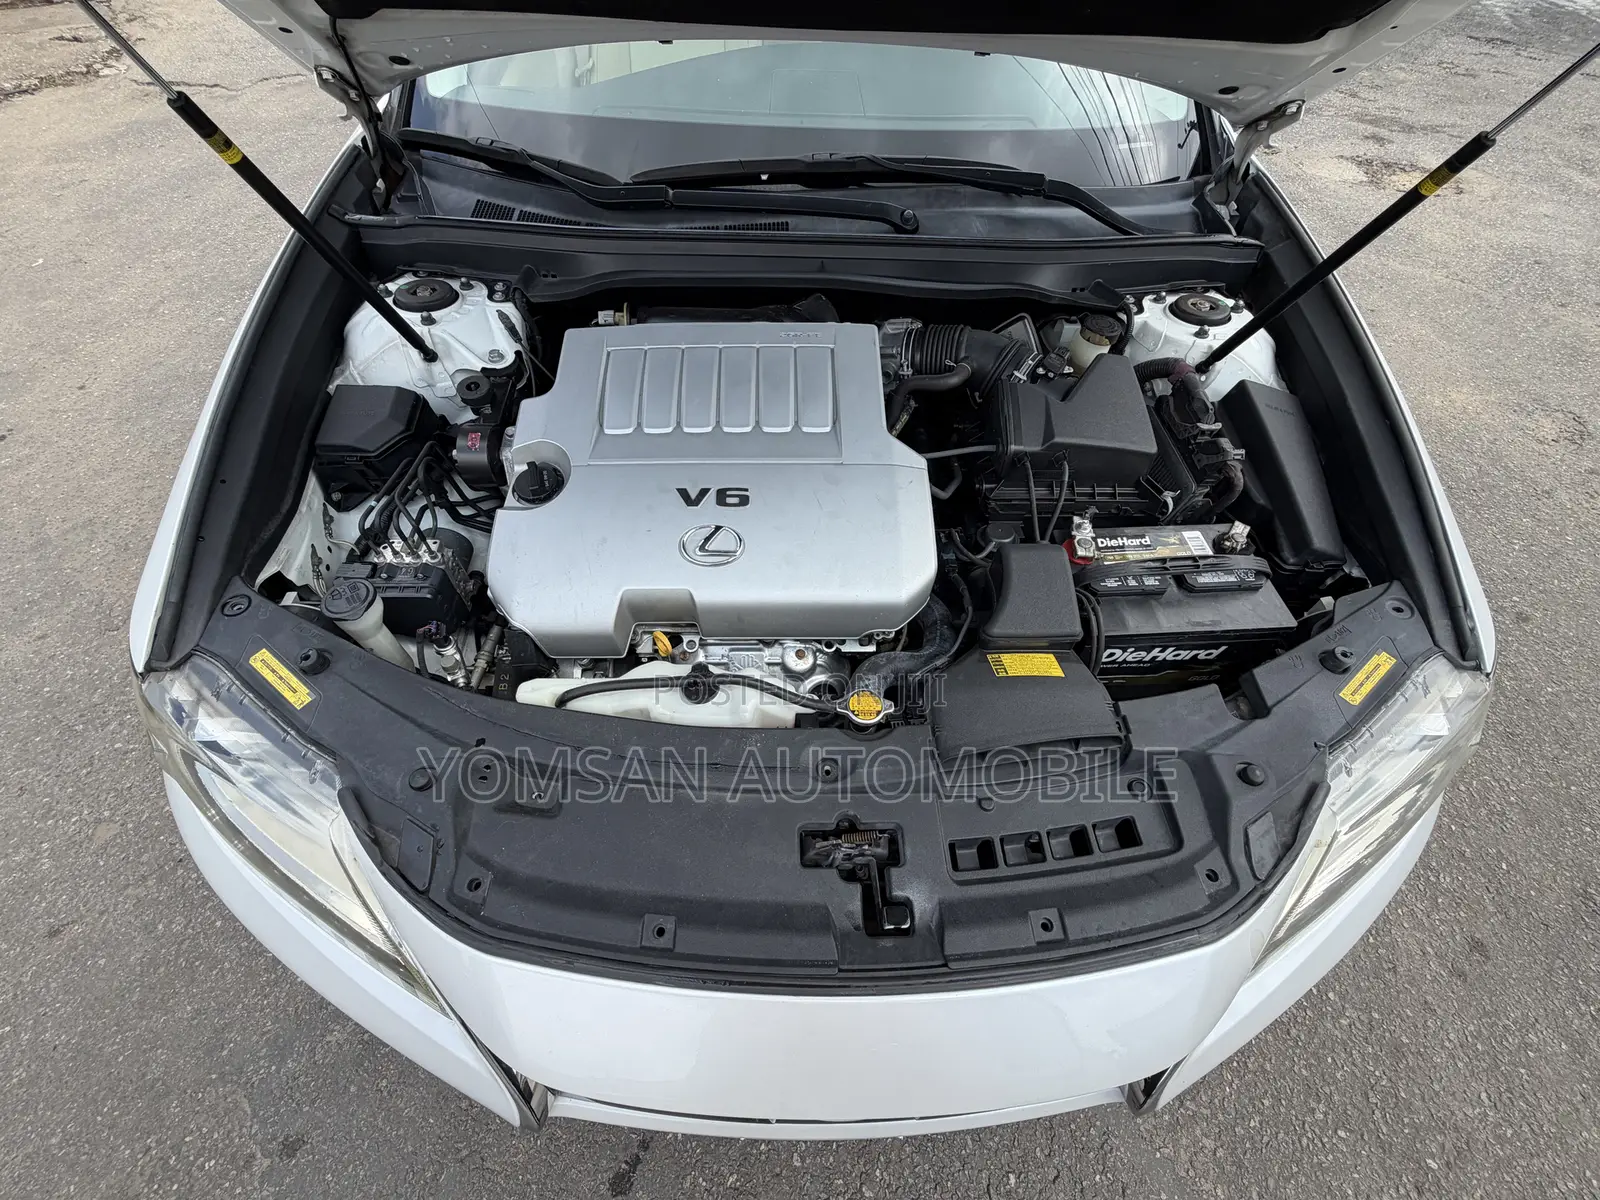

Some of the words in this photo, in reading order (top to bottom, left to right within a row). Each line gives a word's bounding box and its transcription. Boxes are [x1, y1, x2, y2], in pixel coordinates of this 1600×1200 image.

[675, 487, 750, 507] V6
[1097, 535, 1151, 548] DieHard
[1101, 646, 1229, 663] DieHard
